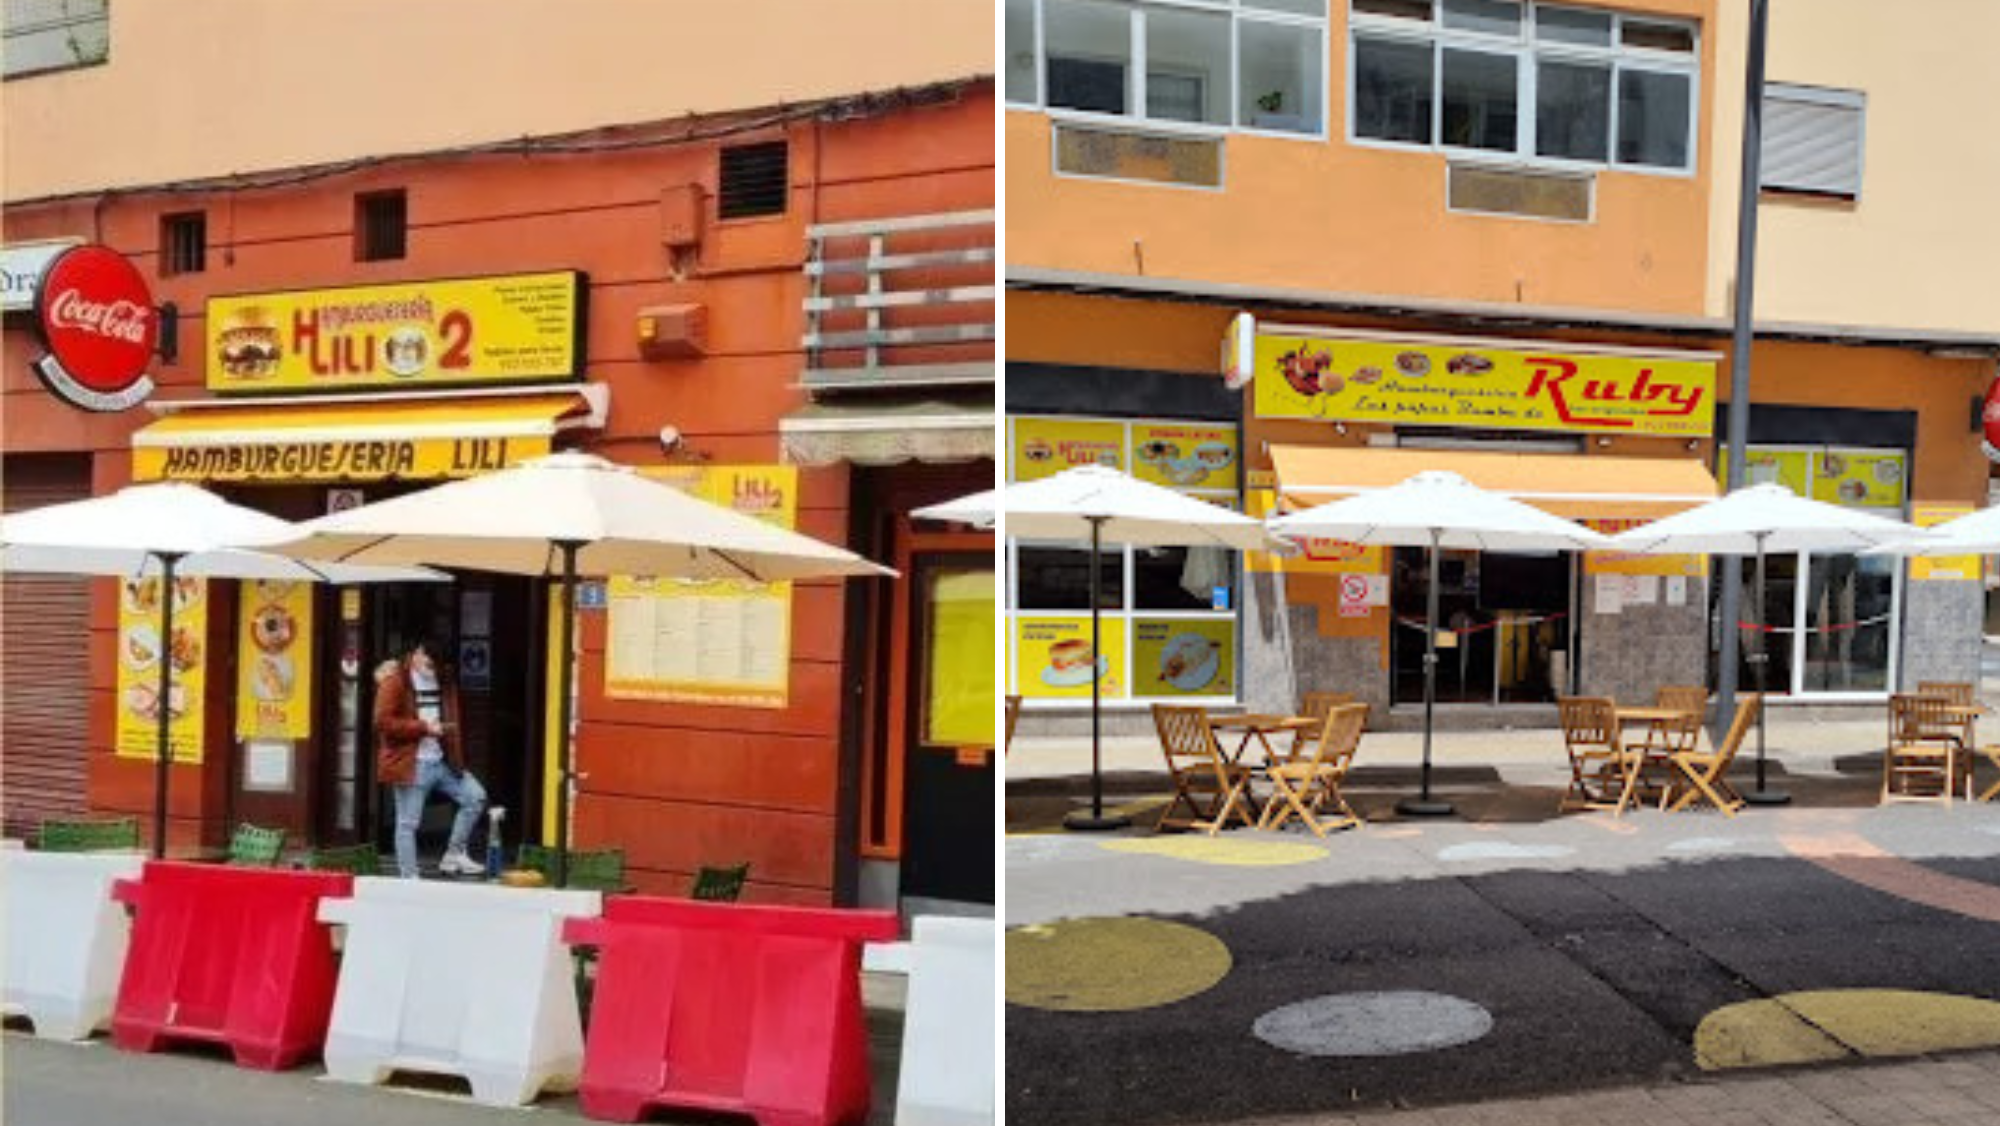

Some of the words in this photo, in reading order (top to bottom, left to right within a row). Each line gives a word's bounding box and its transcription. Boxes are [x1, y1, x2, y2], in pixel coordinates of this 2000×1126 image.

[50, 288, 149, 344] Coca-Cola
[309, 334, 376, 376] LILI
[438, 308, 473, 370] 2
[1522, 357, 1706, 427] Ruby
[451, 437, 508, 471] LILI
